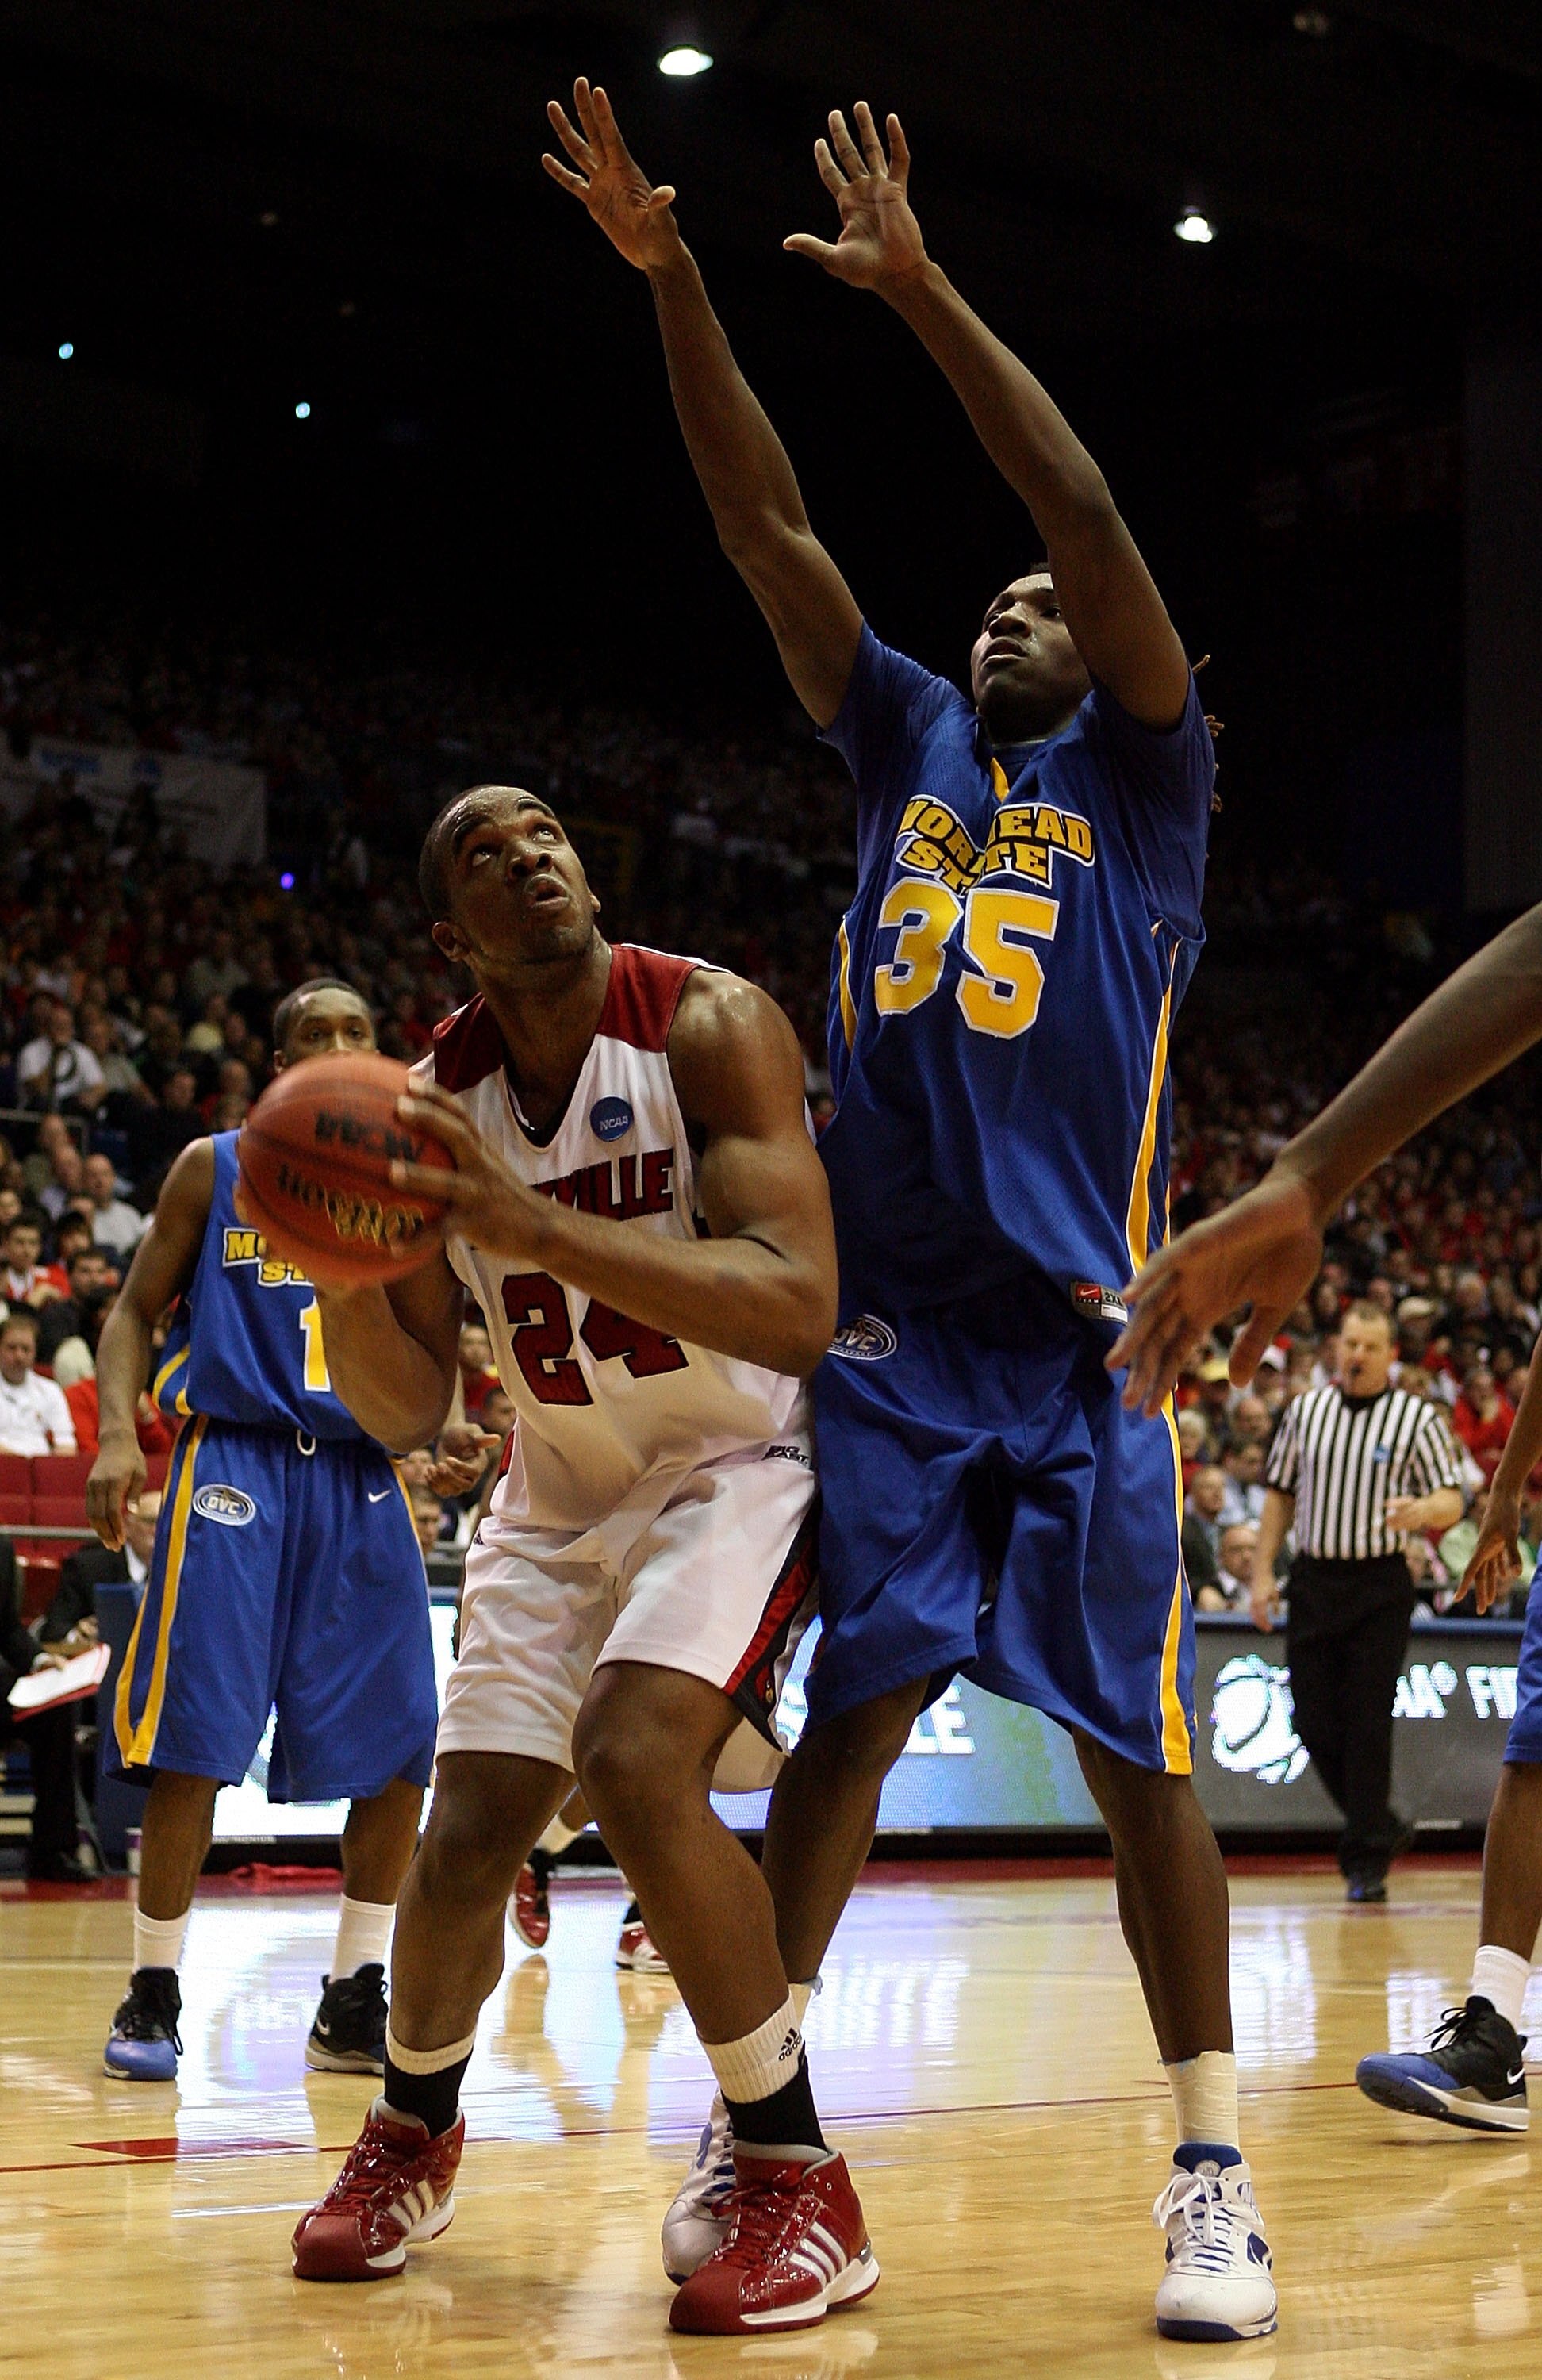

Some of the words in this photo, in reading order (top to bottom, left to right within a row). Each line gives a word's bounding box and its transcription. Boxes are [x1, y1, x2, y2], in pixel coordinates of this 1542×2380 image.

[875, 877, 1059, 1040] 35
[600, 1115, 629, 1131] NCAA
[501, 1271, 689, 1406] 24
[207, 1495, 240, 1515] OVC
[901, 1684, 976, 1755] LE
